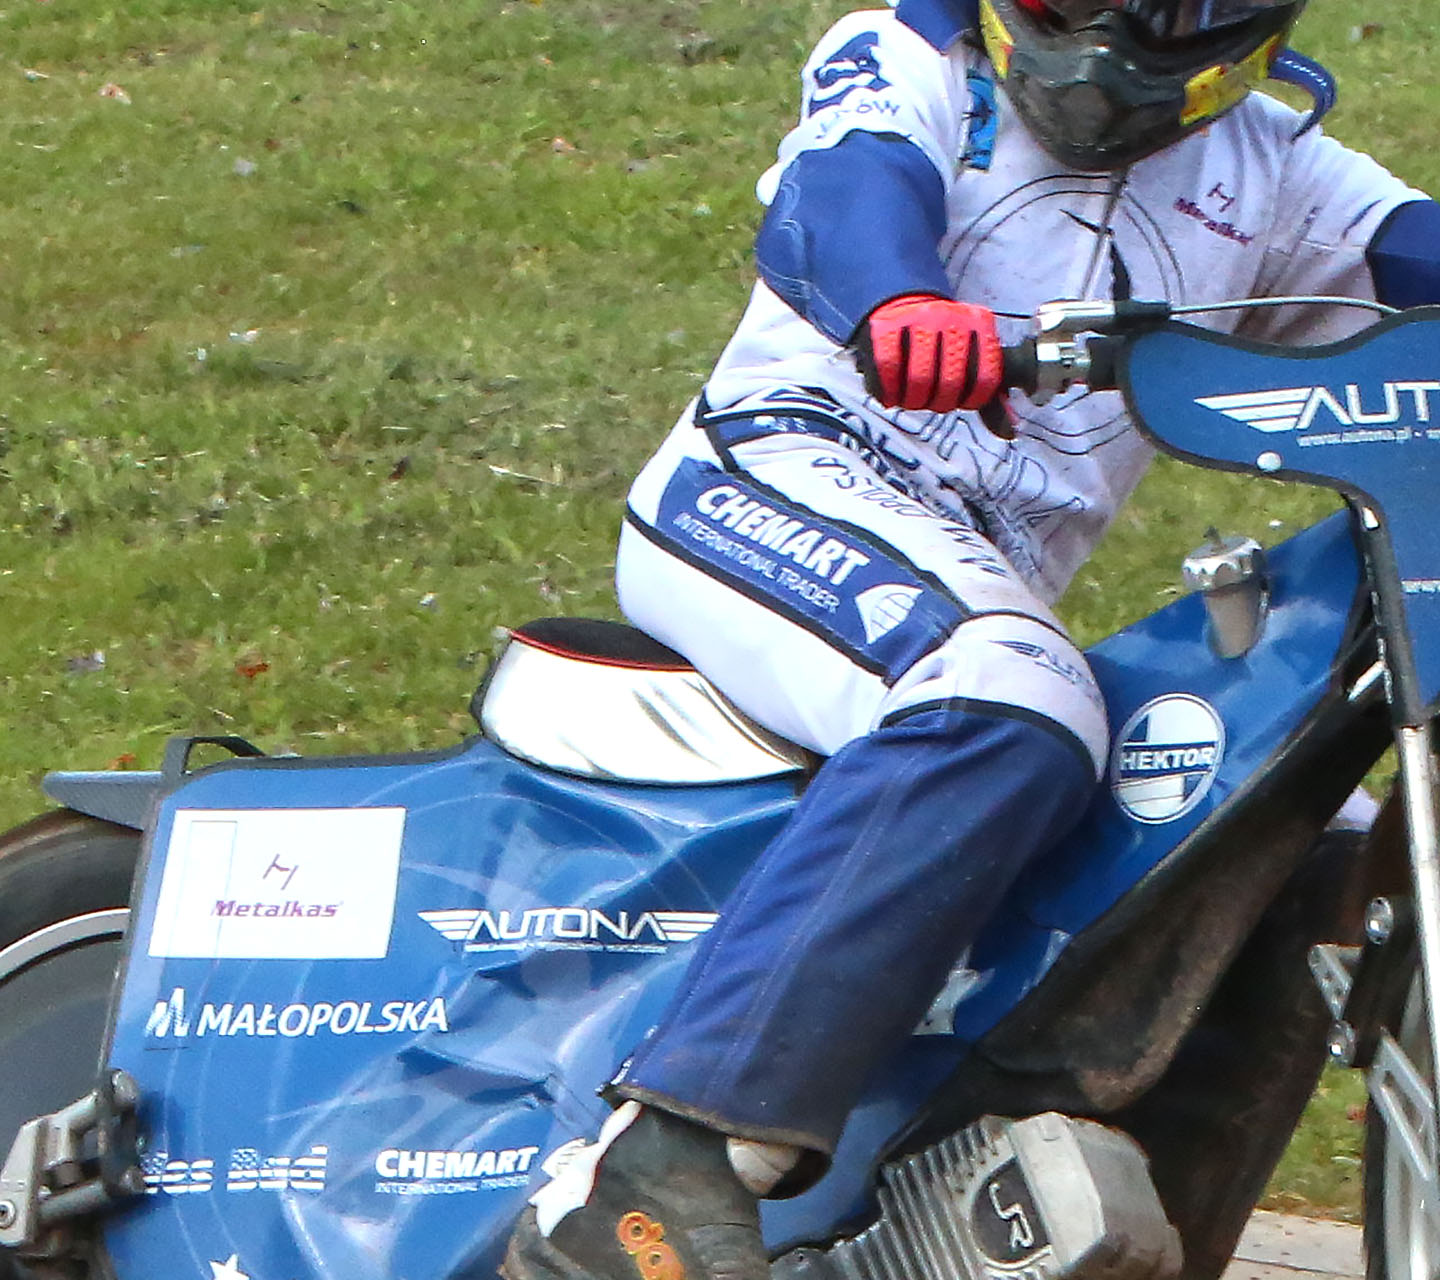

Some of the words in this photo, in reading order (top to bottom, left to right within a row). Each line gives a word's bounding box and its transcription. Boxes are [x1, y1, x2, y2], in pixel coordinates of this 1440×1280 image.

[696, 484, 871, 586] CHEMART
[1121, 746, 1216, 771] HEKTOR
[210, 900, 339, 918] Metalkas
[467, 907, 667, 941] AUTONA
[196, 997, 449, 1038] MAŁOPOLSKA
[375, 1146, 540, 1179] CHEMART
